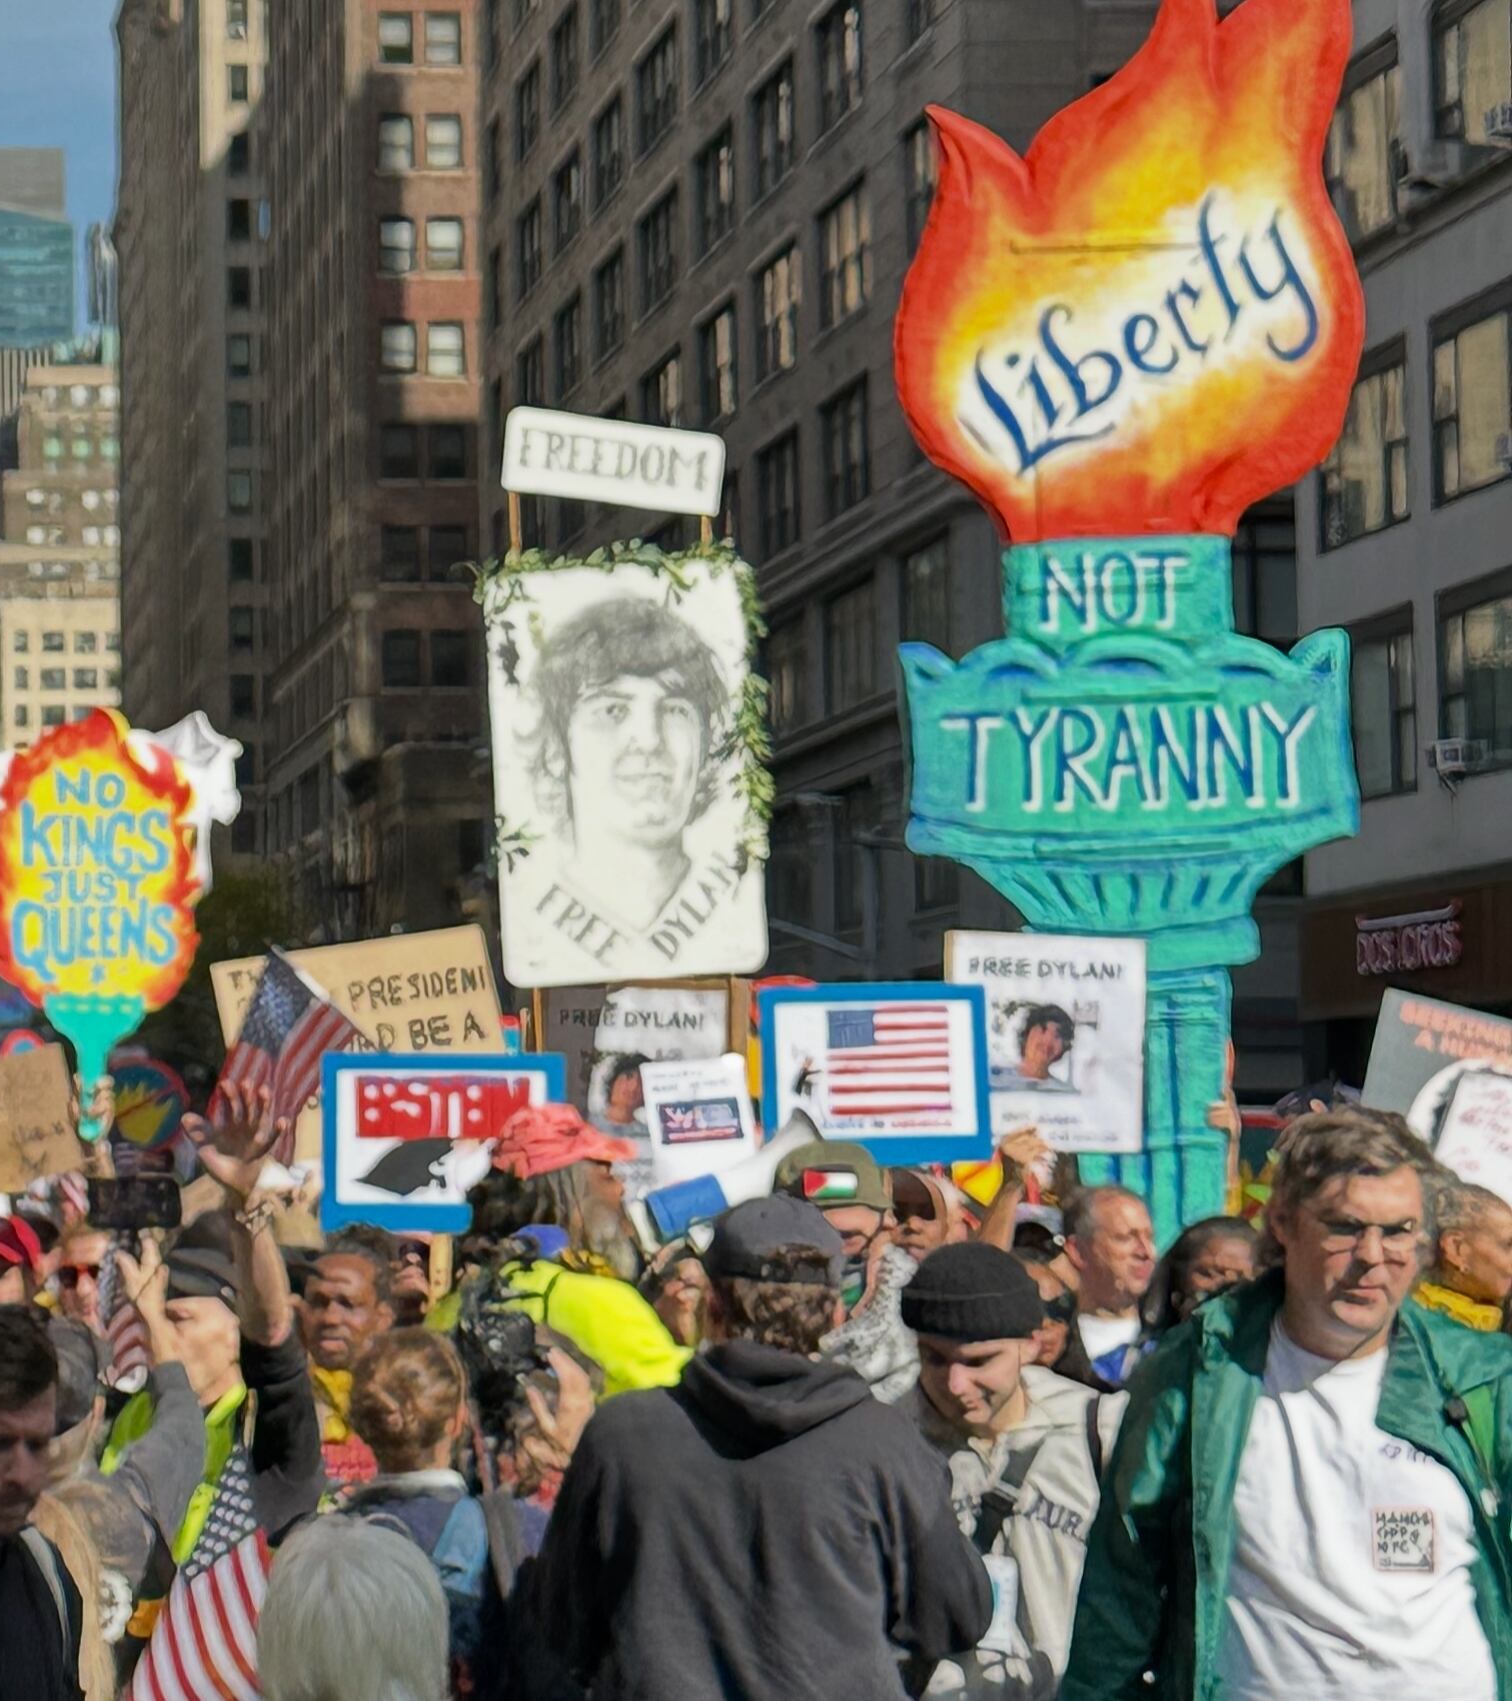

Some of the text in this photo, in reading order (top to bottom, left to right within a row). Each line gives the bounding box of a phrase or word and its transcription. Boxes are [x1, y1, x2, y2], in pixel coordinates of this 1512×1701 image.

[962, 190, 1318, 474] Liberty
[520, 427, 707, 492] FREEDOM
[1038, 550, 1190, 634] NOT
[55, 768, 125, 809] NO
[942, 705, 1316, 814] TYRANNY
[20, 801, 170, 874] KINGS
[41, 869, 146, 903] JUST
[12, 897, 179, 983] QUEENS
[536, 882, 632, 967] FREE
[968, 957, 1032, 977] FREE
[408, 1015, 452, 1051] BE
[463, 1010, 486, 1042] A
